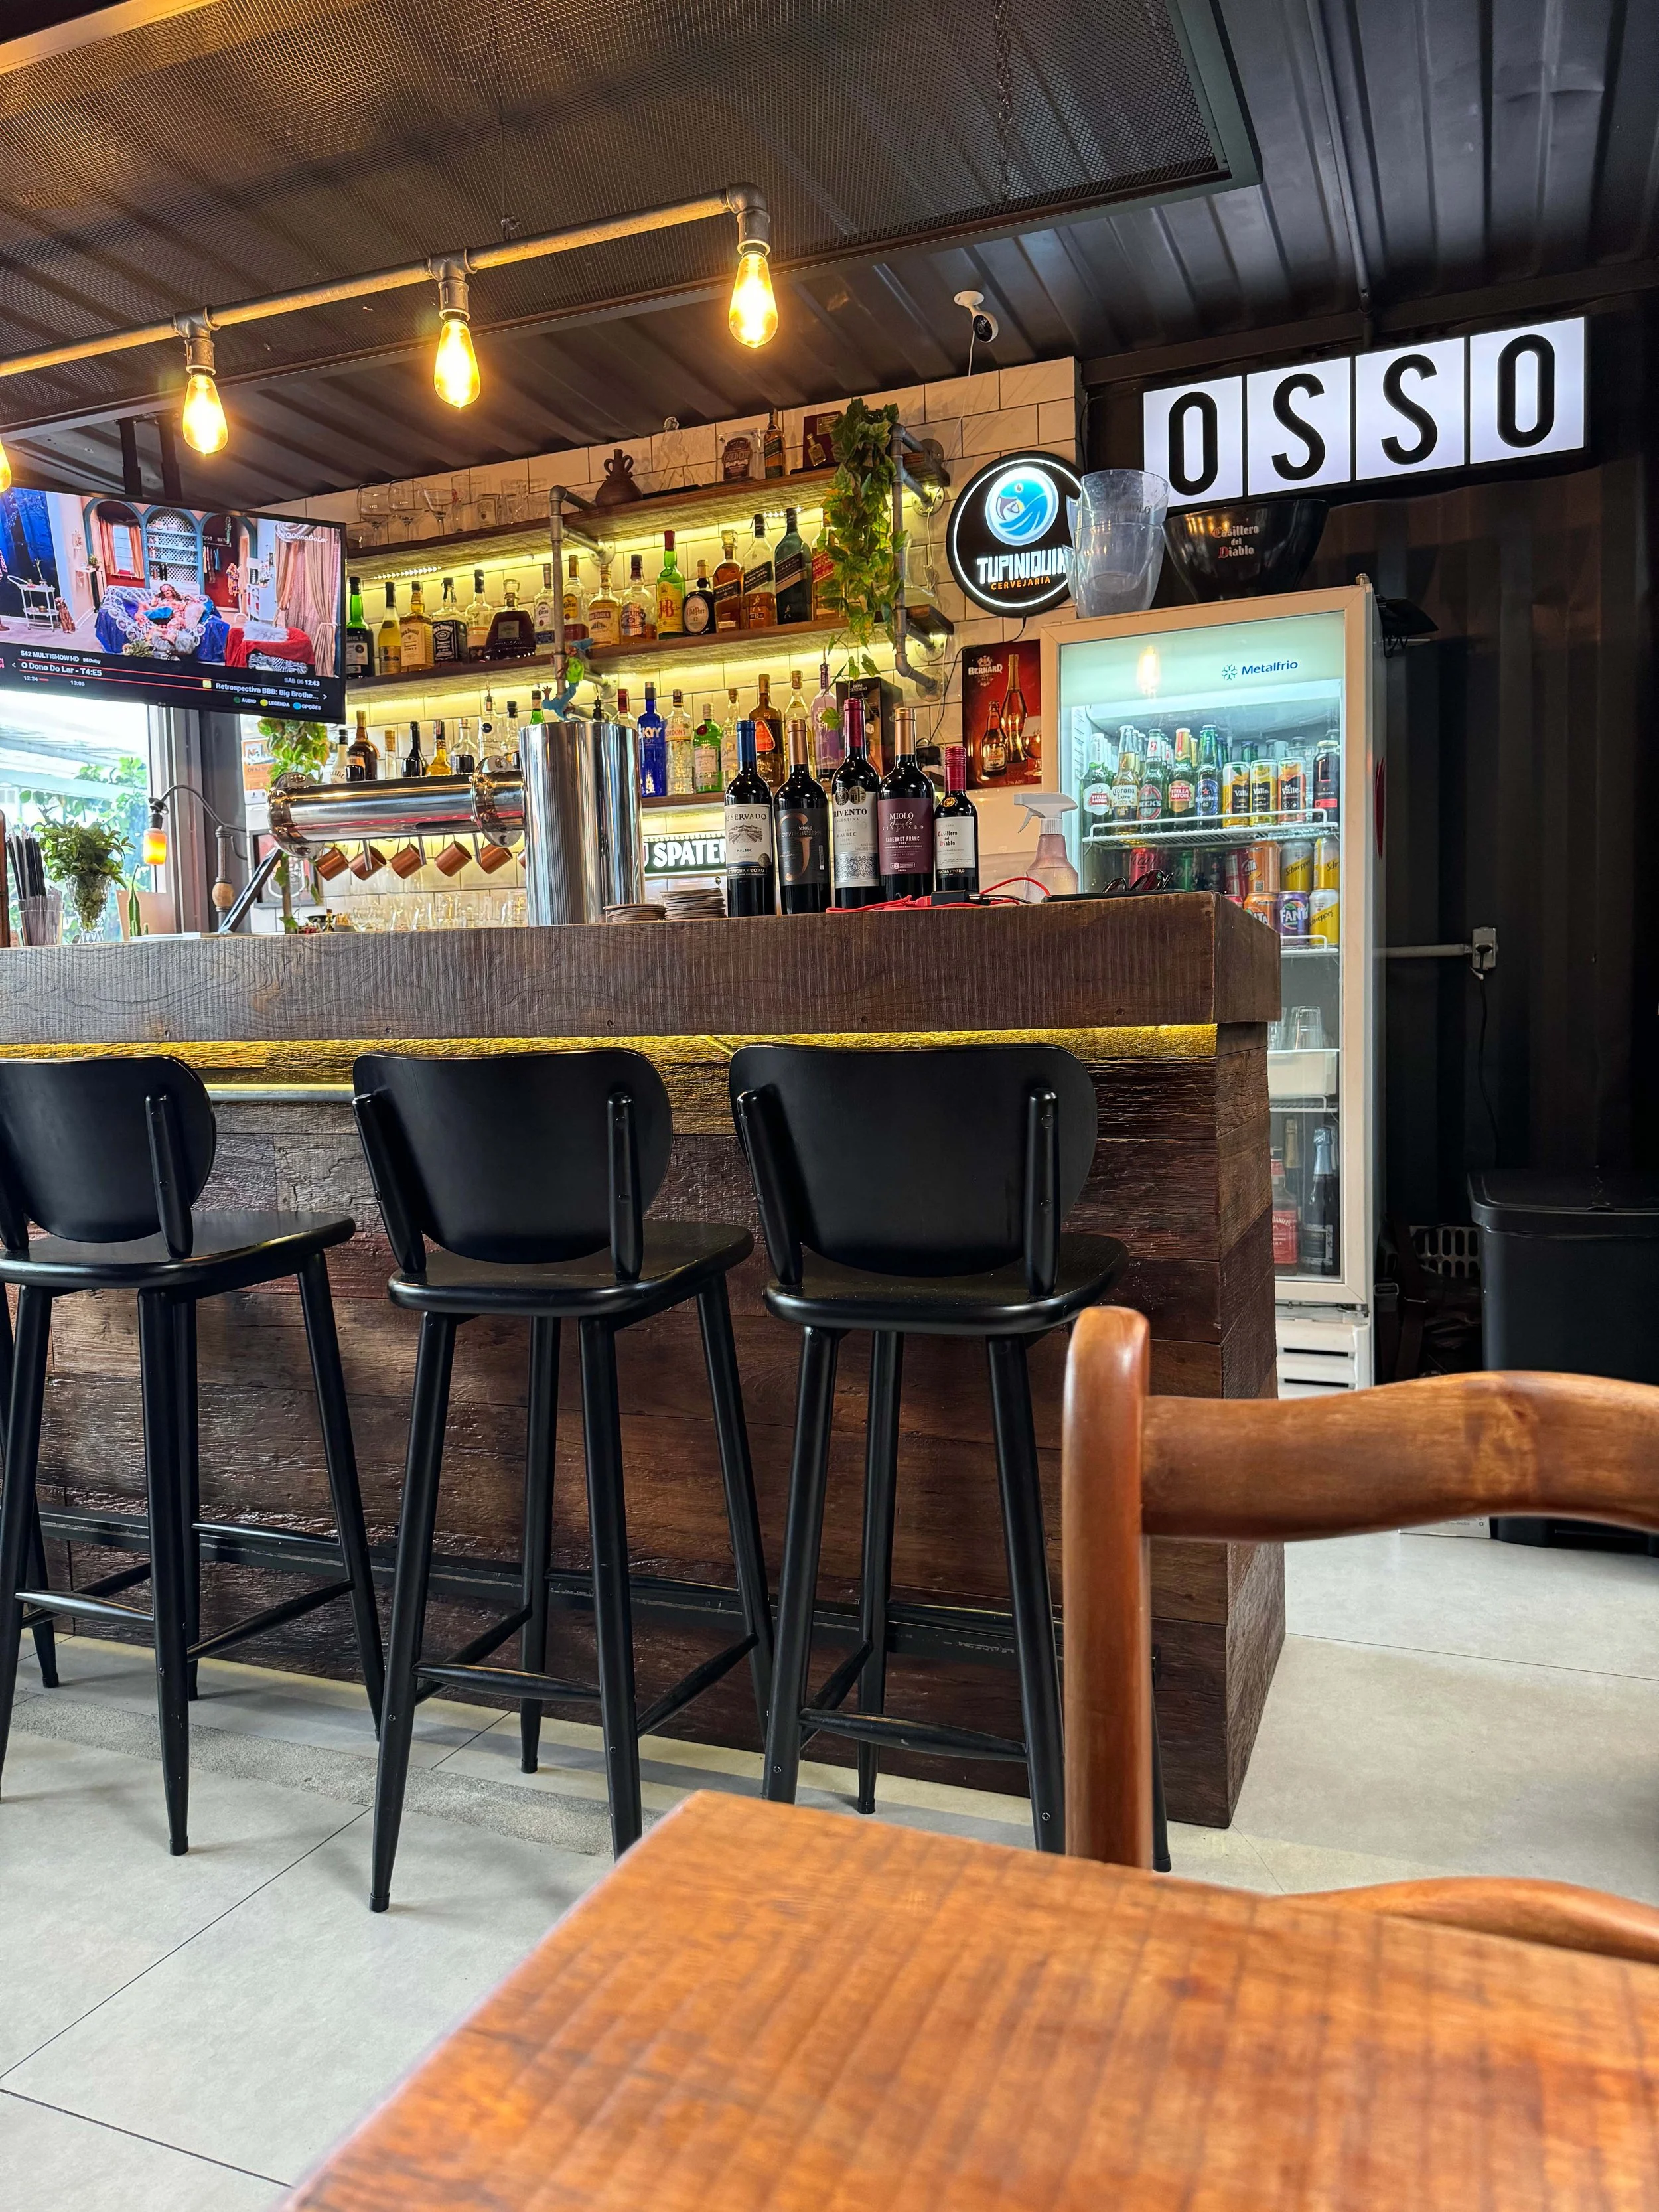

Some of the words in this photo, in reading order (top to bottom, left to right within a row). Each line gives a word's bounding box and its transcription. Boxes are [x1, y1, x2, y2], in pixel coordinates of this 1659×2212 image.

[1169, 334, 1555, 496] OSSO
[1212, 524, 1260, 539] Casillero
[1231, 538, 1242, 546] del
[1218, 545, 1255, 559] Diablo
[991, 576, 1051, 591] CERVEJARIA
[33, 652, 71, 662] MULTISHOW
[29, 662, 48, 672] Dono
[80, 668, 102, 676] T4:E5
[968, 664, 1003, 675] BERNARD
[1242, 660, 1298, 675] Metalfrio
[216, 682, 261, 694] Retrospectiva
[279, 689, 290, 698] Big
[726, 813, 766, 822] RESERVADO
[833, 808, 867, 818] RIVENTO
[1310, 910, 1333, 926] chweppes
